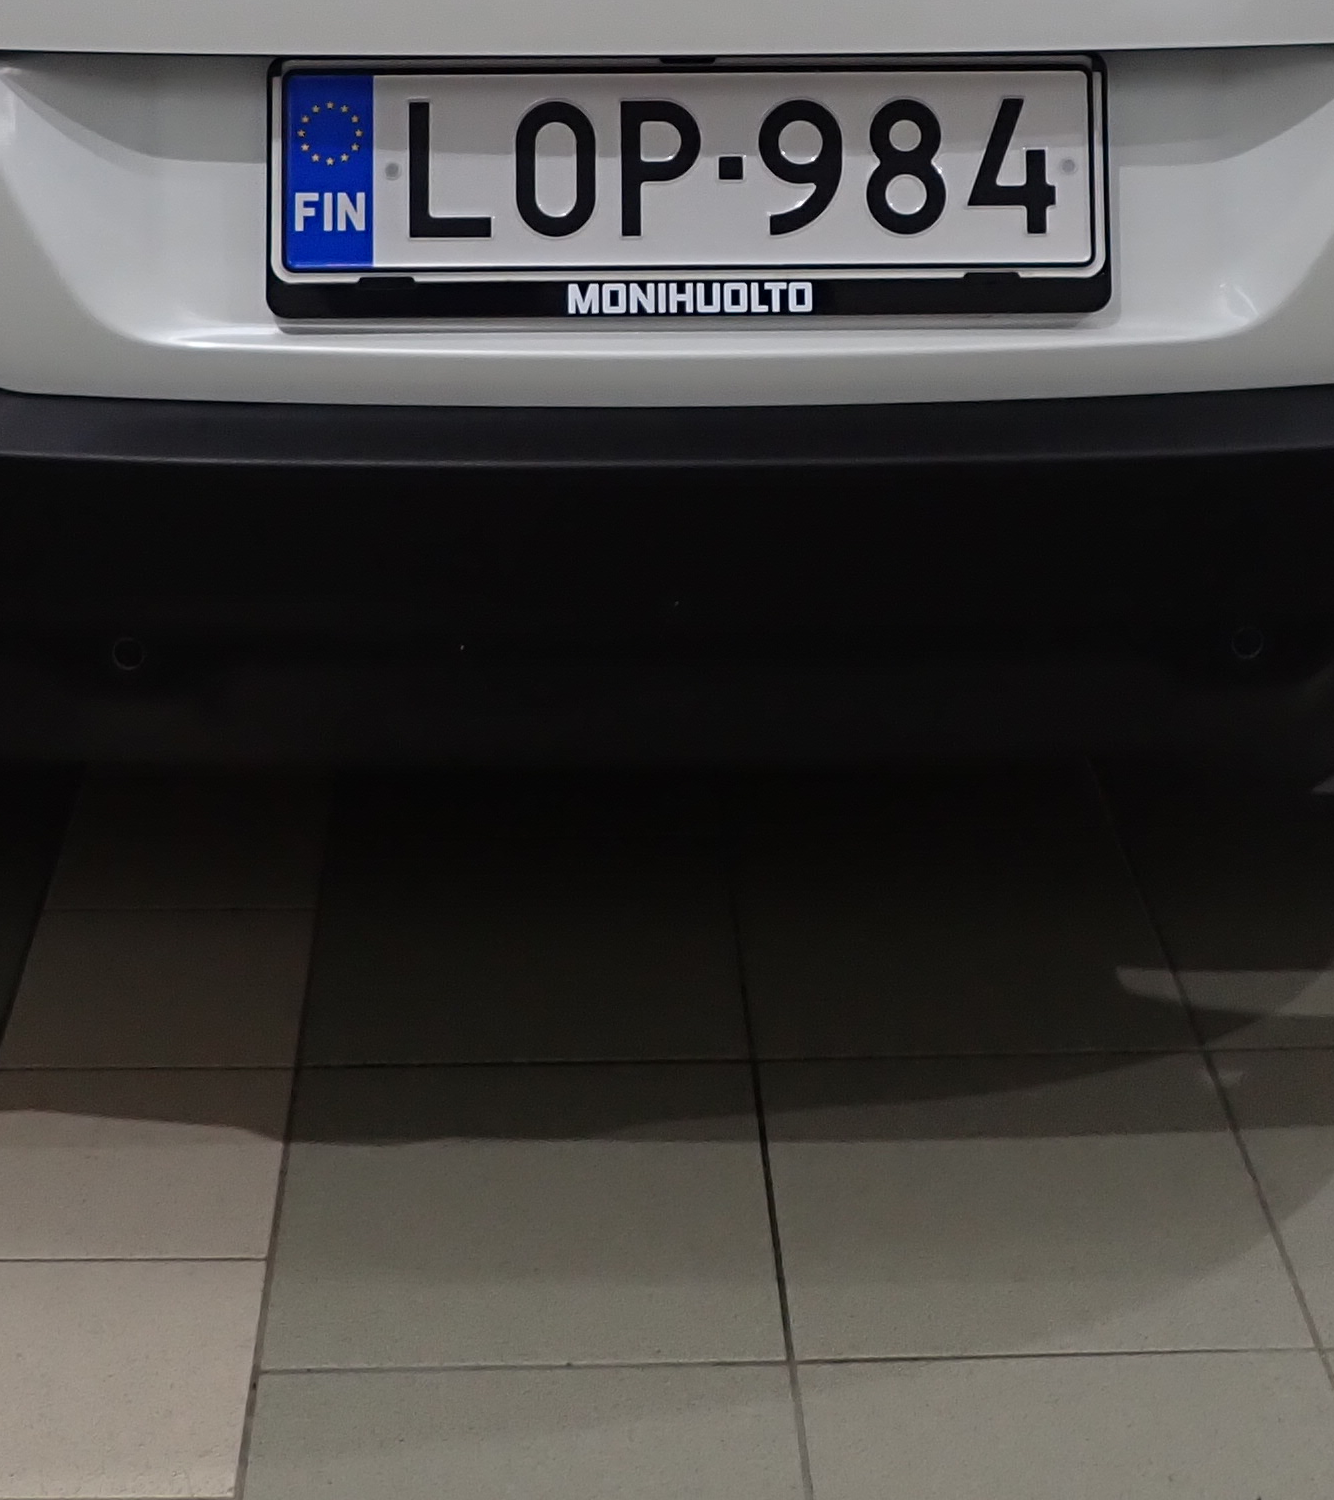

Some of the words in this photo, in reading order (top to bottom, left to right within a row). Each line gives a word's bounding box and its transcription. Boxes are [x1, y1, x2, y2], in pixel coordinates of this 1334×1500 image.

[408, 98, 1057, 238] LOP-984
[294, 192, 366, 232] FIN
[568, 282, 813, 315] MONIHUOLTO
